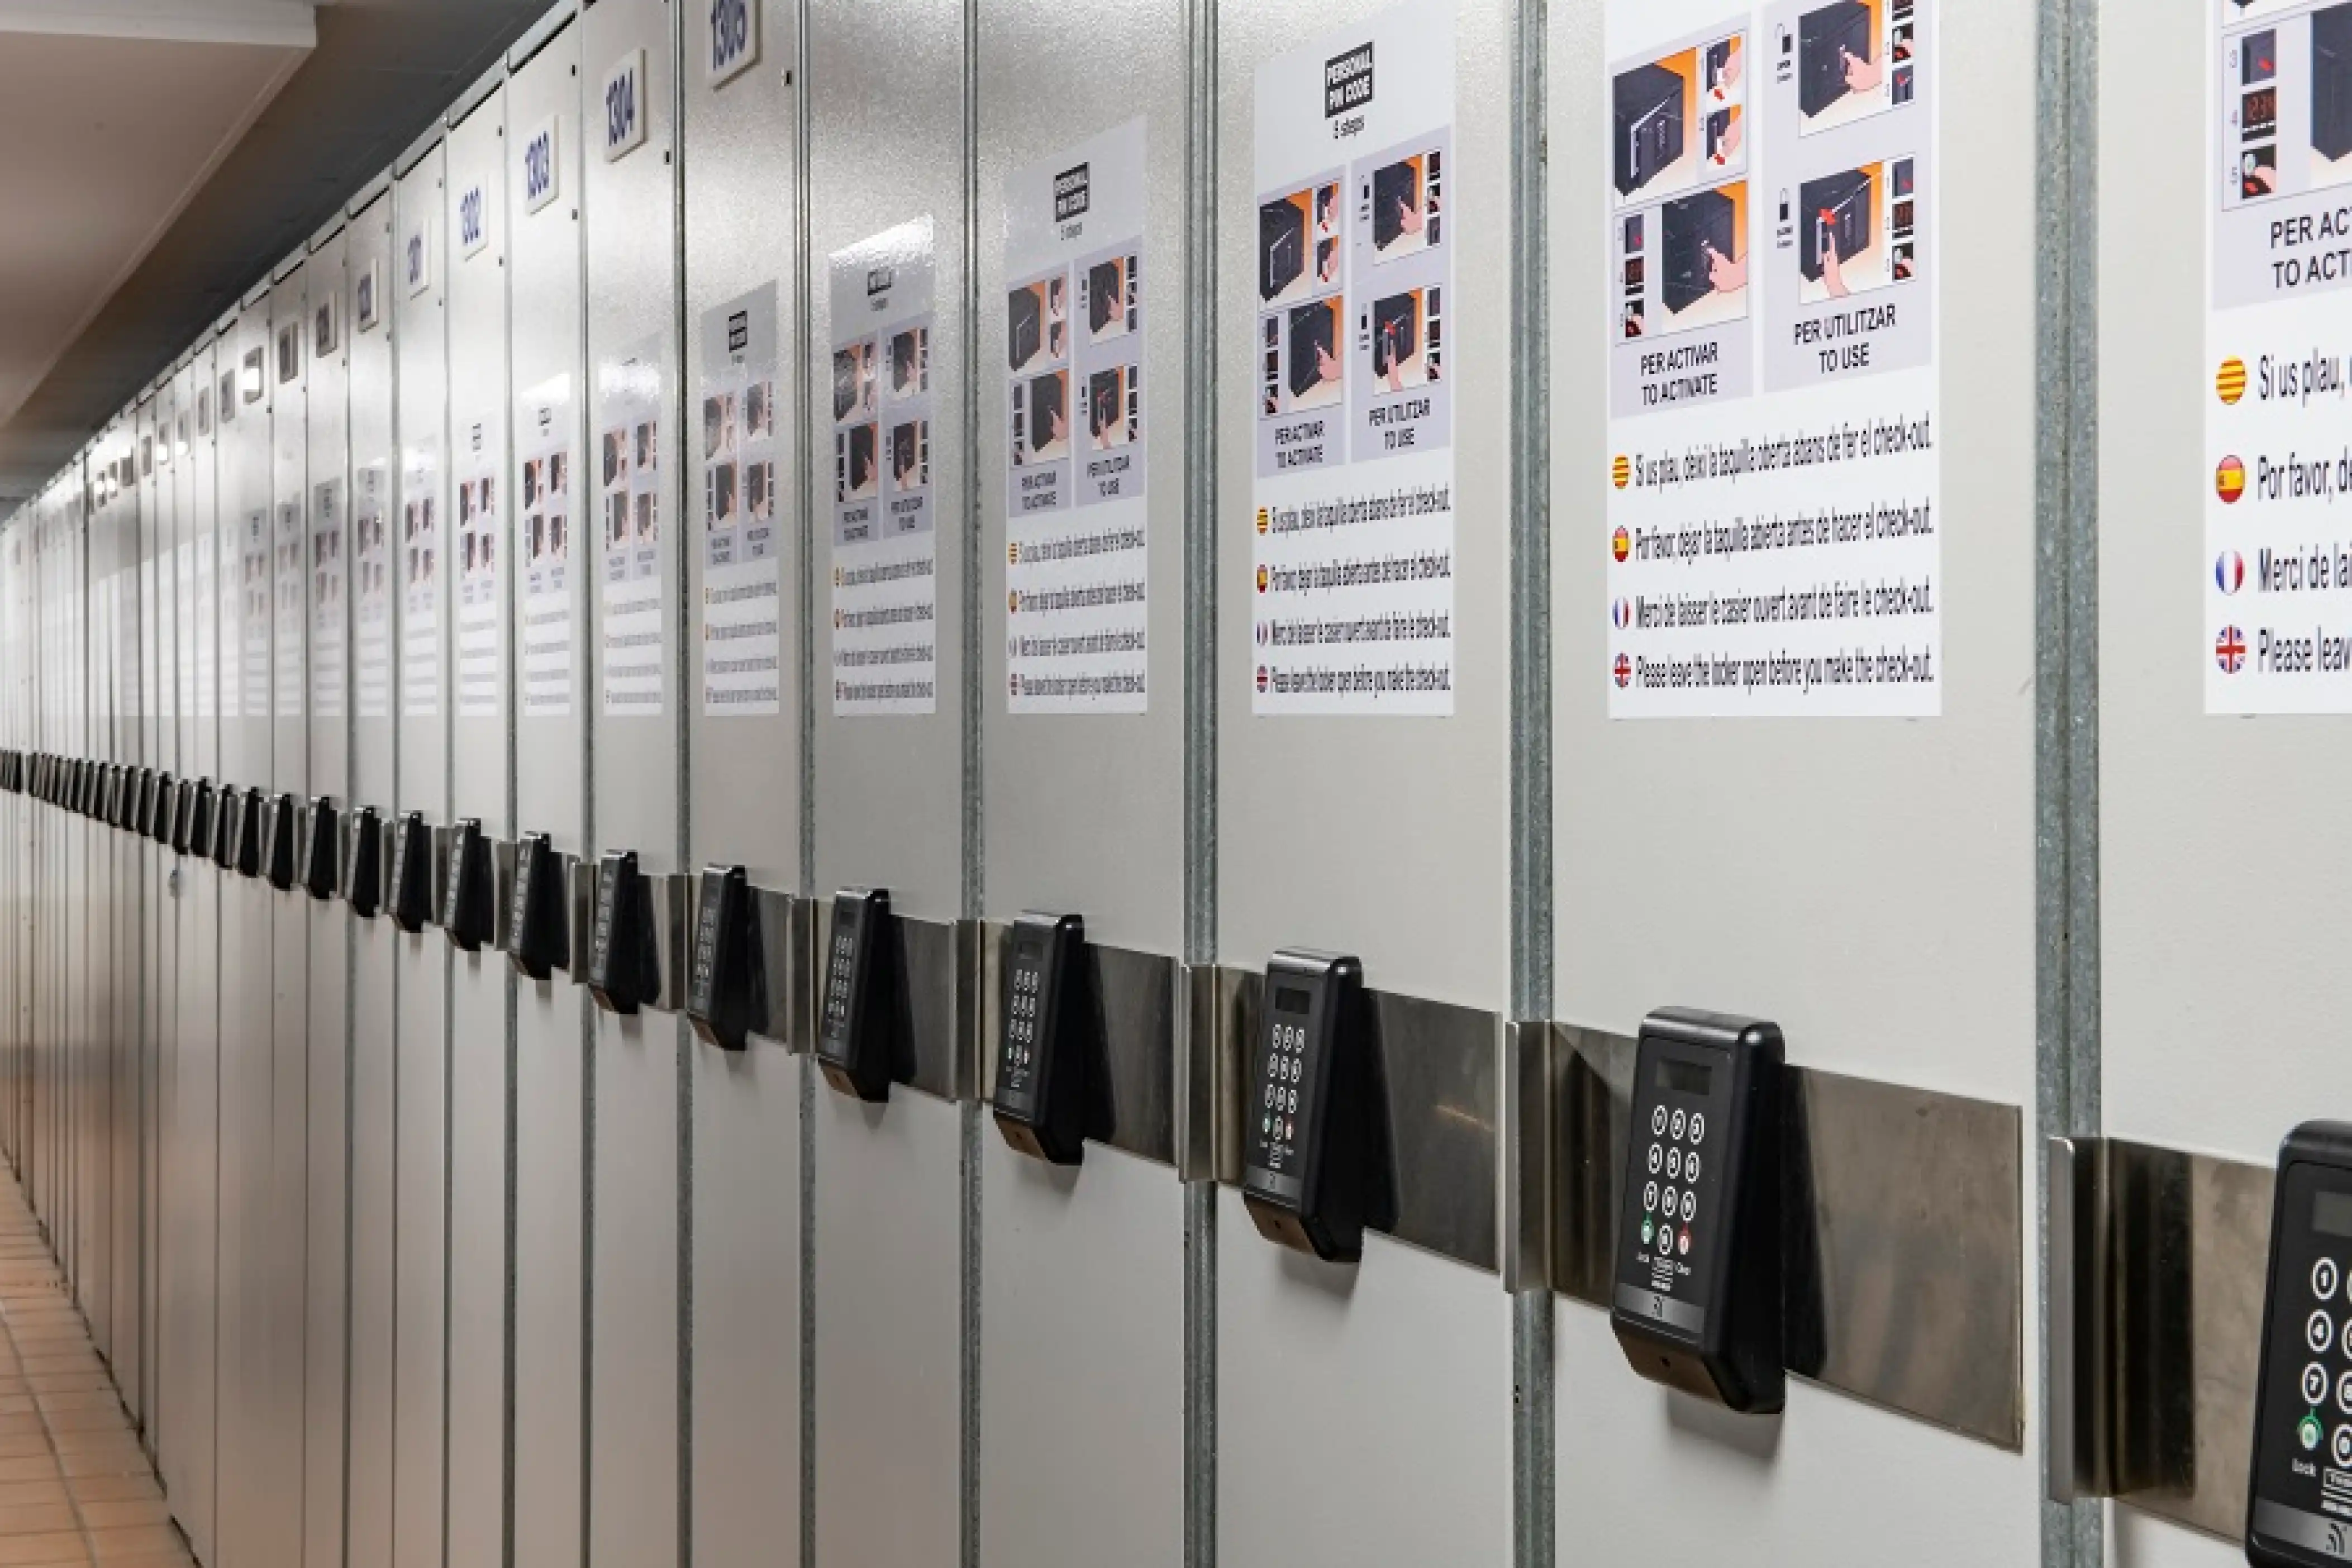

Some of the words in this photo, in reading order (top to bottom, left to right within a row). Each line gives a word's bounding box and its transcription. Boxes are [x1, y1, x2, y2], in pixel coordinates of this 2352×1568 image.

[606, 66, 634, 147] 1304
[2270, 215, 2313, 249] PER
[2318, 206, 2352, 239] AC
[2271, 258, 2301, 289] TO
[1793, 318, 1822, 345] PER
[1823, 303, 1896, 340] UTILITZAR
[1641, 352, 1665, 376] PER
[1667, 342, 1718, 372] ACTIVAR
[1818, 350, 1839, 374] TO
[1842, 342, 1870, 369] USE
[2258, 354, 2274, 401] Si
[2279, 363, 2298, 397] us
[2302, 347, 2345, 408] plau,
[1641, 384, 1658, 406] TO
[2258, 454, 2284, 501] Por
[2289, 451, 2334, 505] favor,
[2258, 543, 2304, 593] Merci
[2308, 543, 2329, 591] de
[2258, 626, 2313, 674] Please
